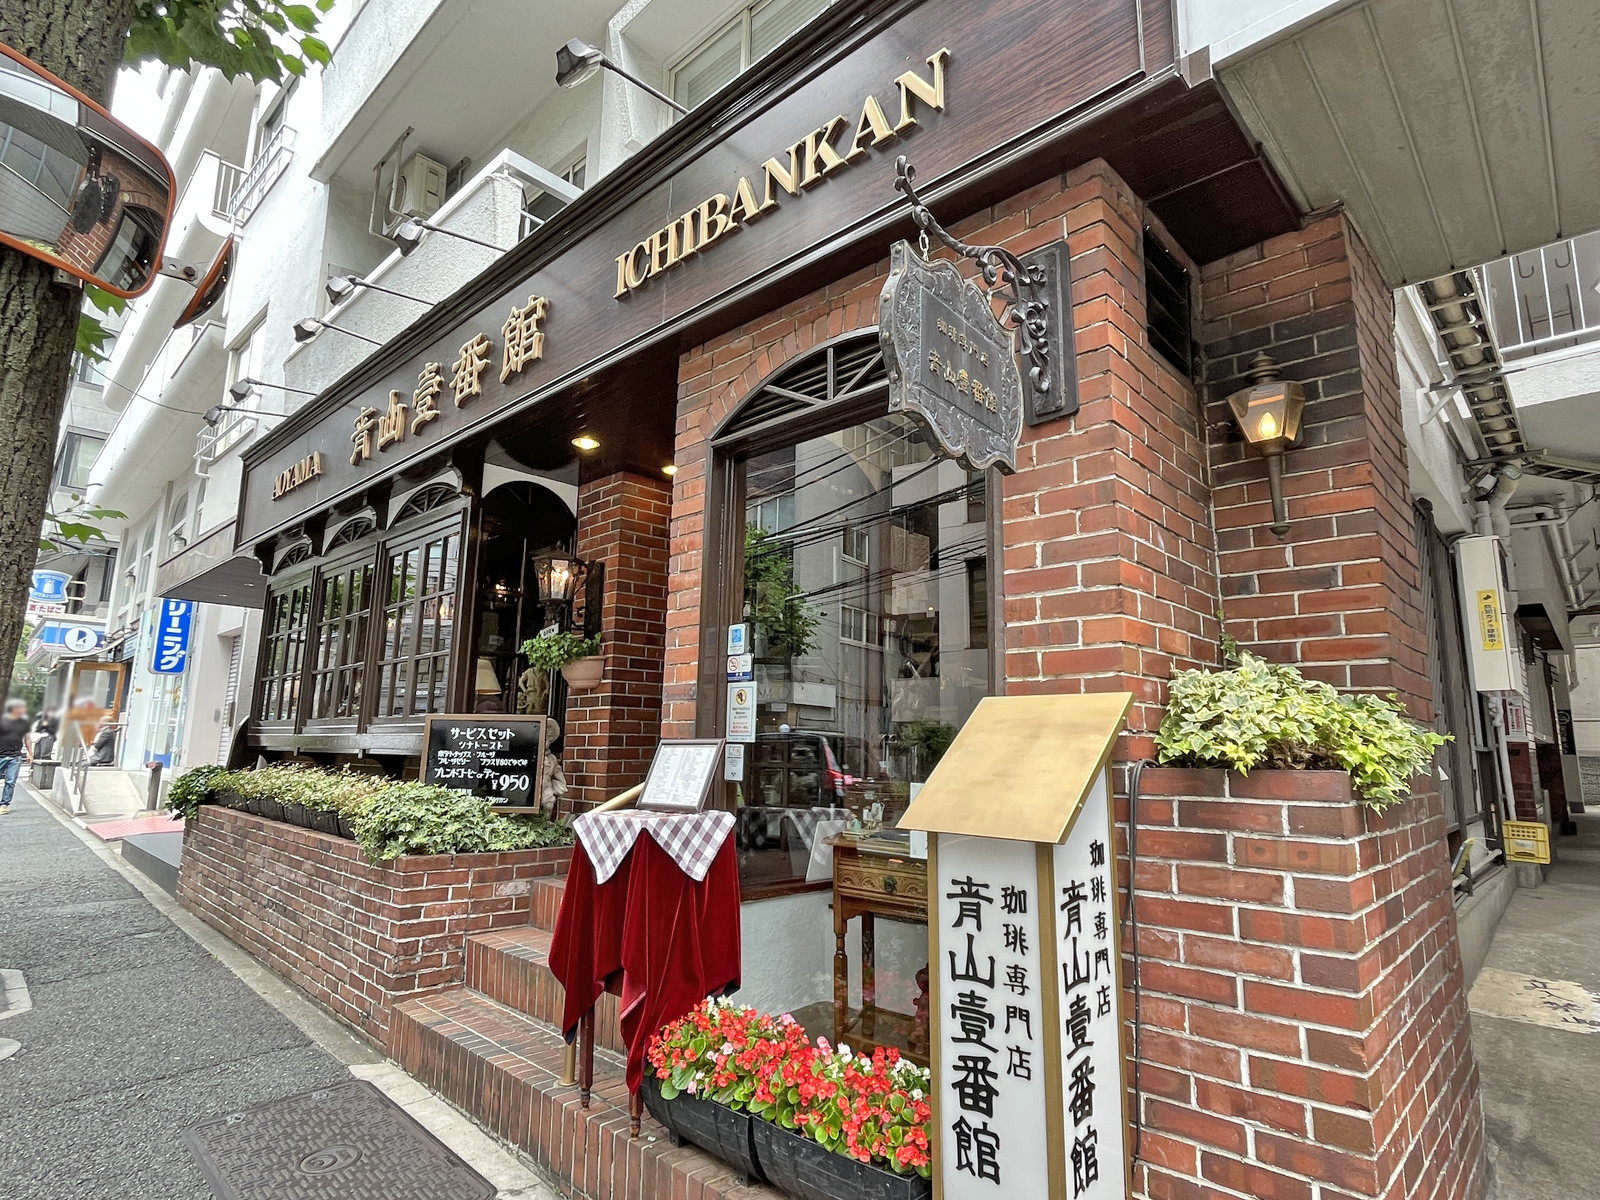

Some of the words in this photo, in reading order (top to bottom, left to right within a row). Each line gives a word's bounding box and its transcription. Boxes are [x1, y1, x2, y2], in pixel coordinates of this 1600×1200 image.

[271, 451, 323, 501] AOYAMA
[613, 47, 952, 300] ICHIBANKAN
[160, 598, 187, 670] リーニング
[1000, 885, 1034, 1081] 珈琲専門店
[1090, 839, 1112, 1018] 珈琲専門店
